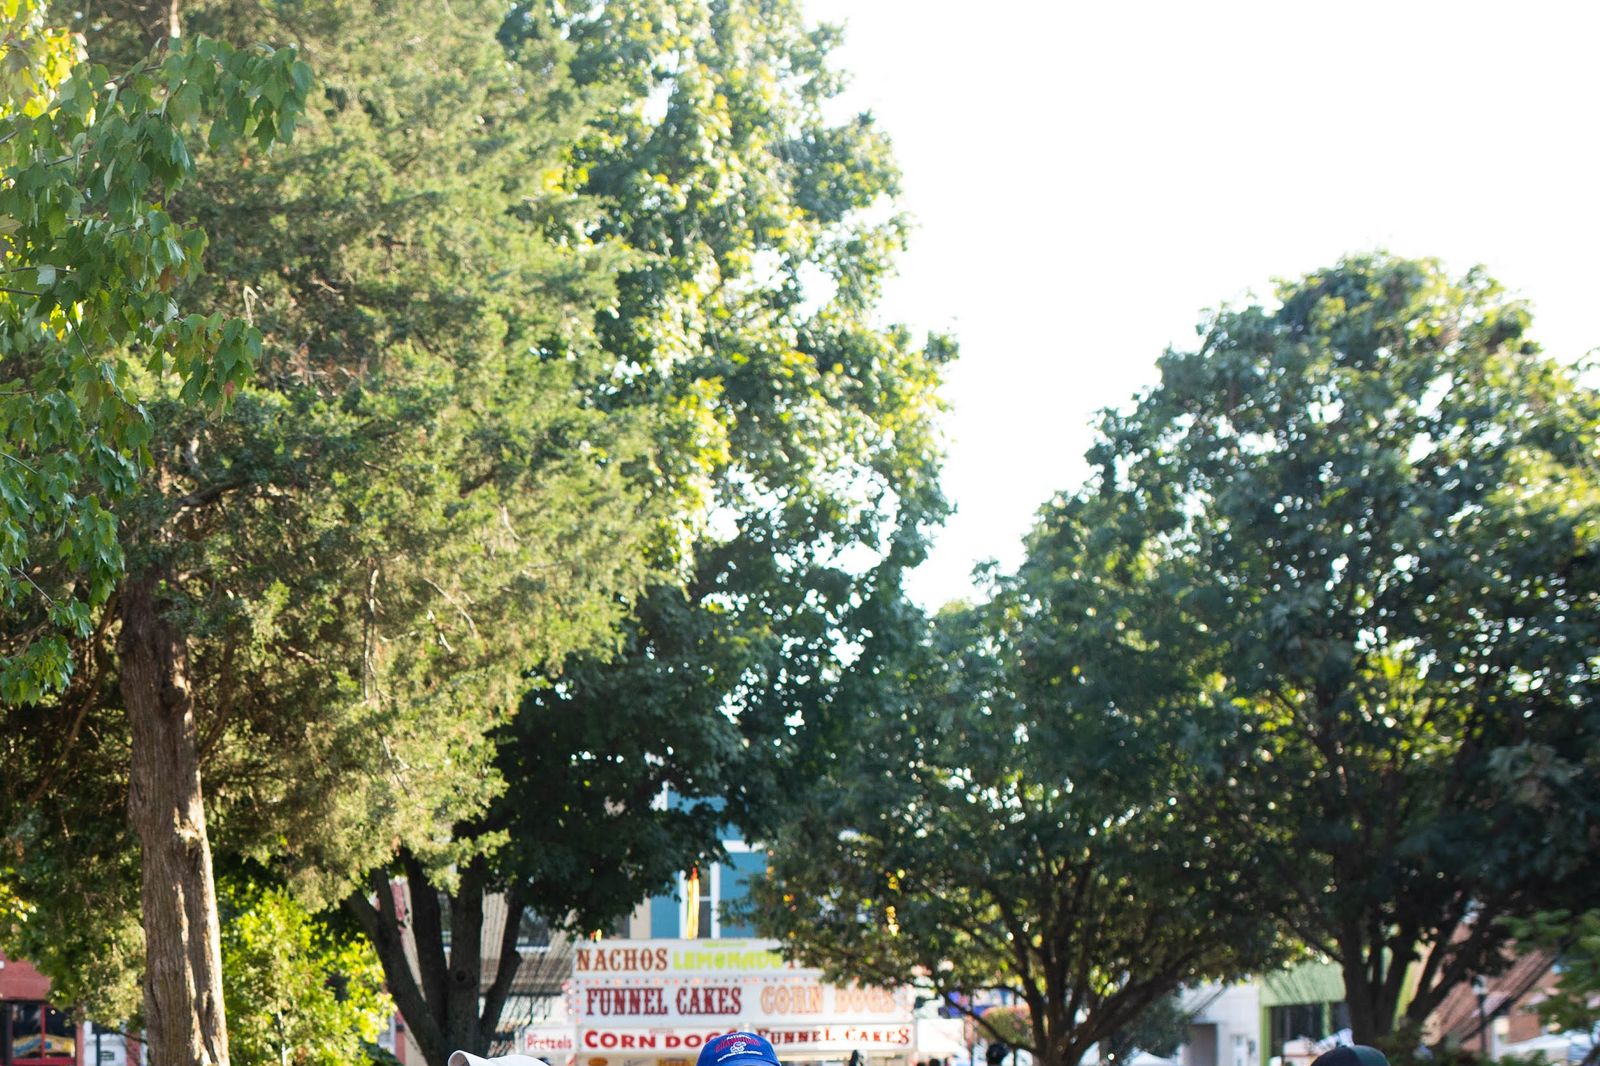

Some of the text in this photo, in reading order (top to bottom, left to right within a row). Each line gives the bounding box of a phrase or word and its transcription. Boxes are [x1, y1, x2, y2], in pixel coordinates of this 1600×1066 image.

[576, 948, 668, 972] NACHOS
[586, 987, 668, 1016] FUNNEL
[675, 986, 742, 1015] CAKES
[760, 985, 823, 1014] CORN
[527, 1033, 572, 1049] Pretzels
[584, 1030, 656, 1048] CORN
[845, 1028, 910, 1044] CAKES
